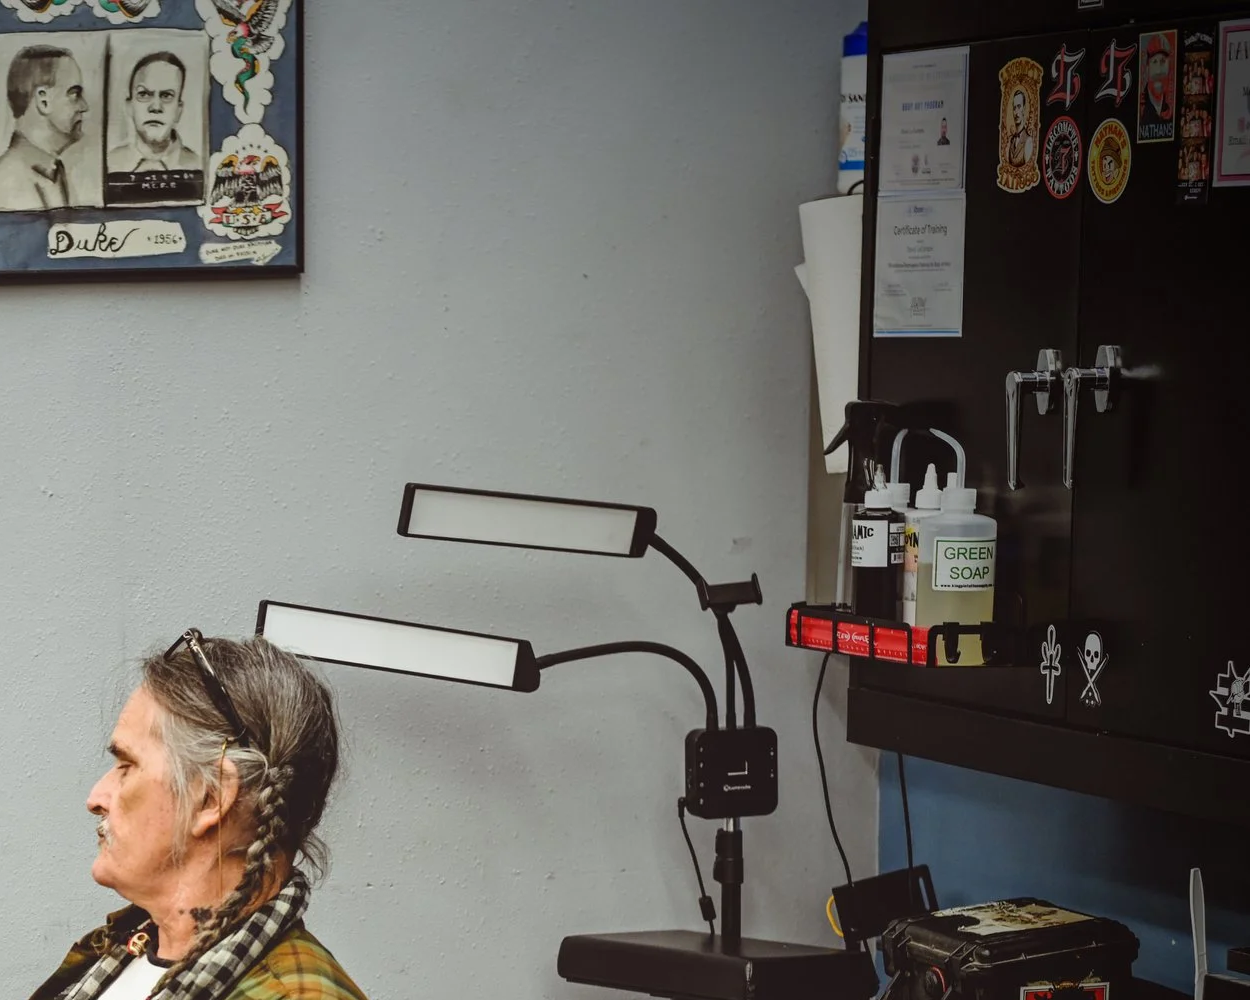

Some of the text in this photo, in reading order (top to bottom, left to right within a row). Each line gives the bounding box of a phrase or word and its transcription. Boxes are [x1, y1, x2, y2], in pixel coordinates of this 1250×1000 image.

[1139, 123, 1173, 138] NATHANS
[894, 224, 948, 237] Certificate of Training
[944, 546, 994, 561] GREEN
[949, 566, 990, 580] SOAP
